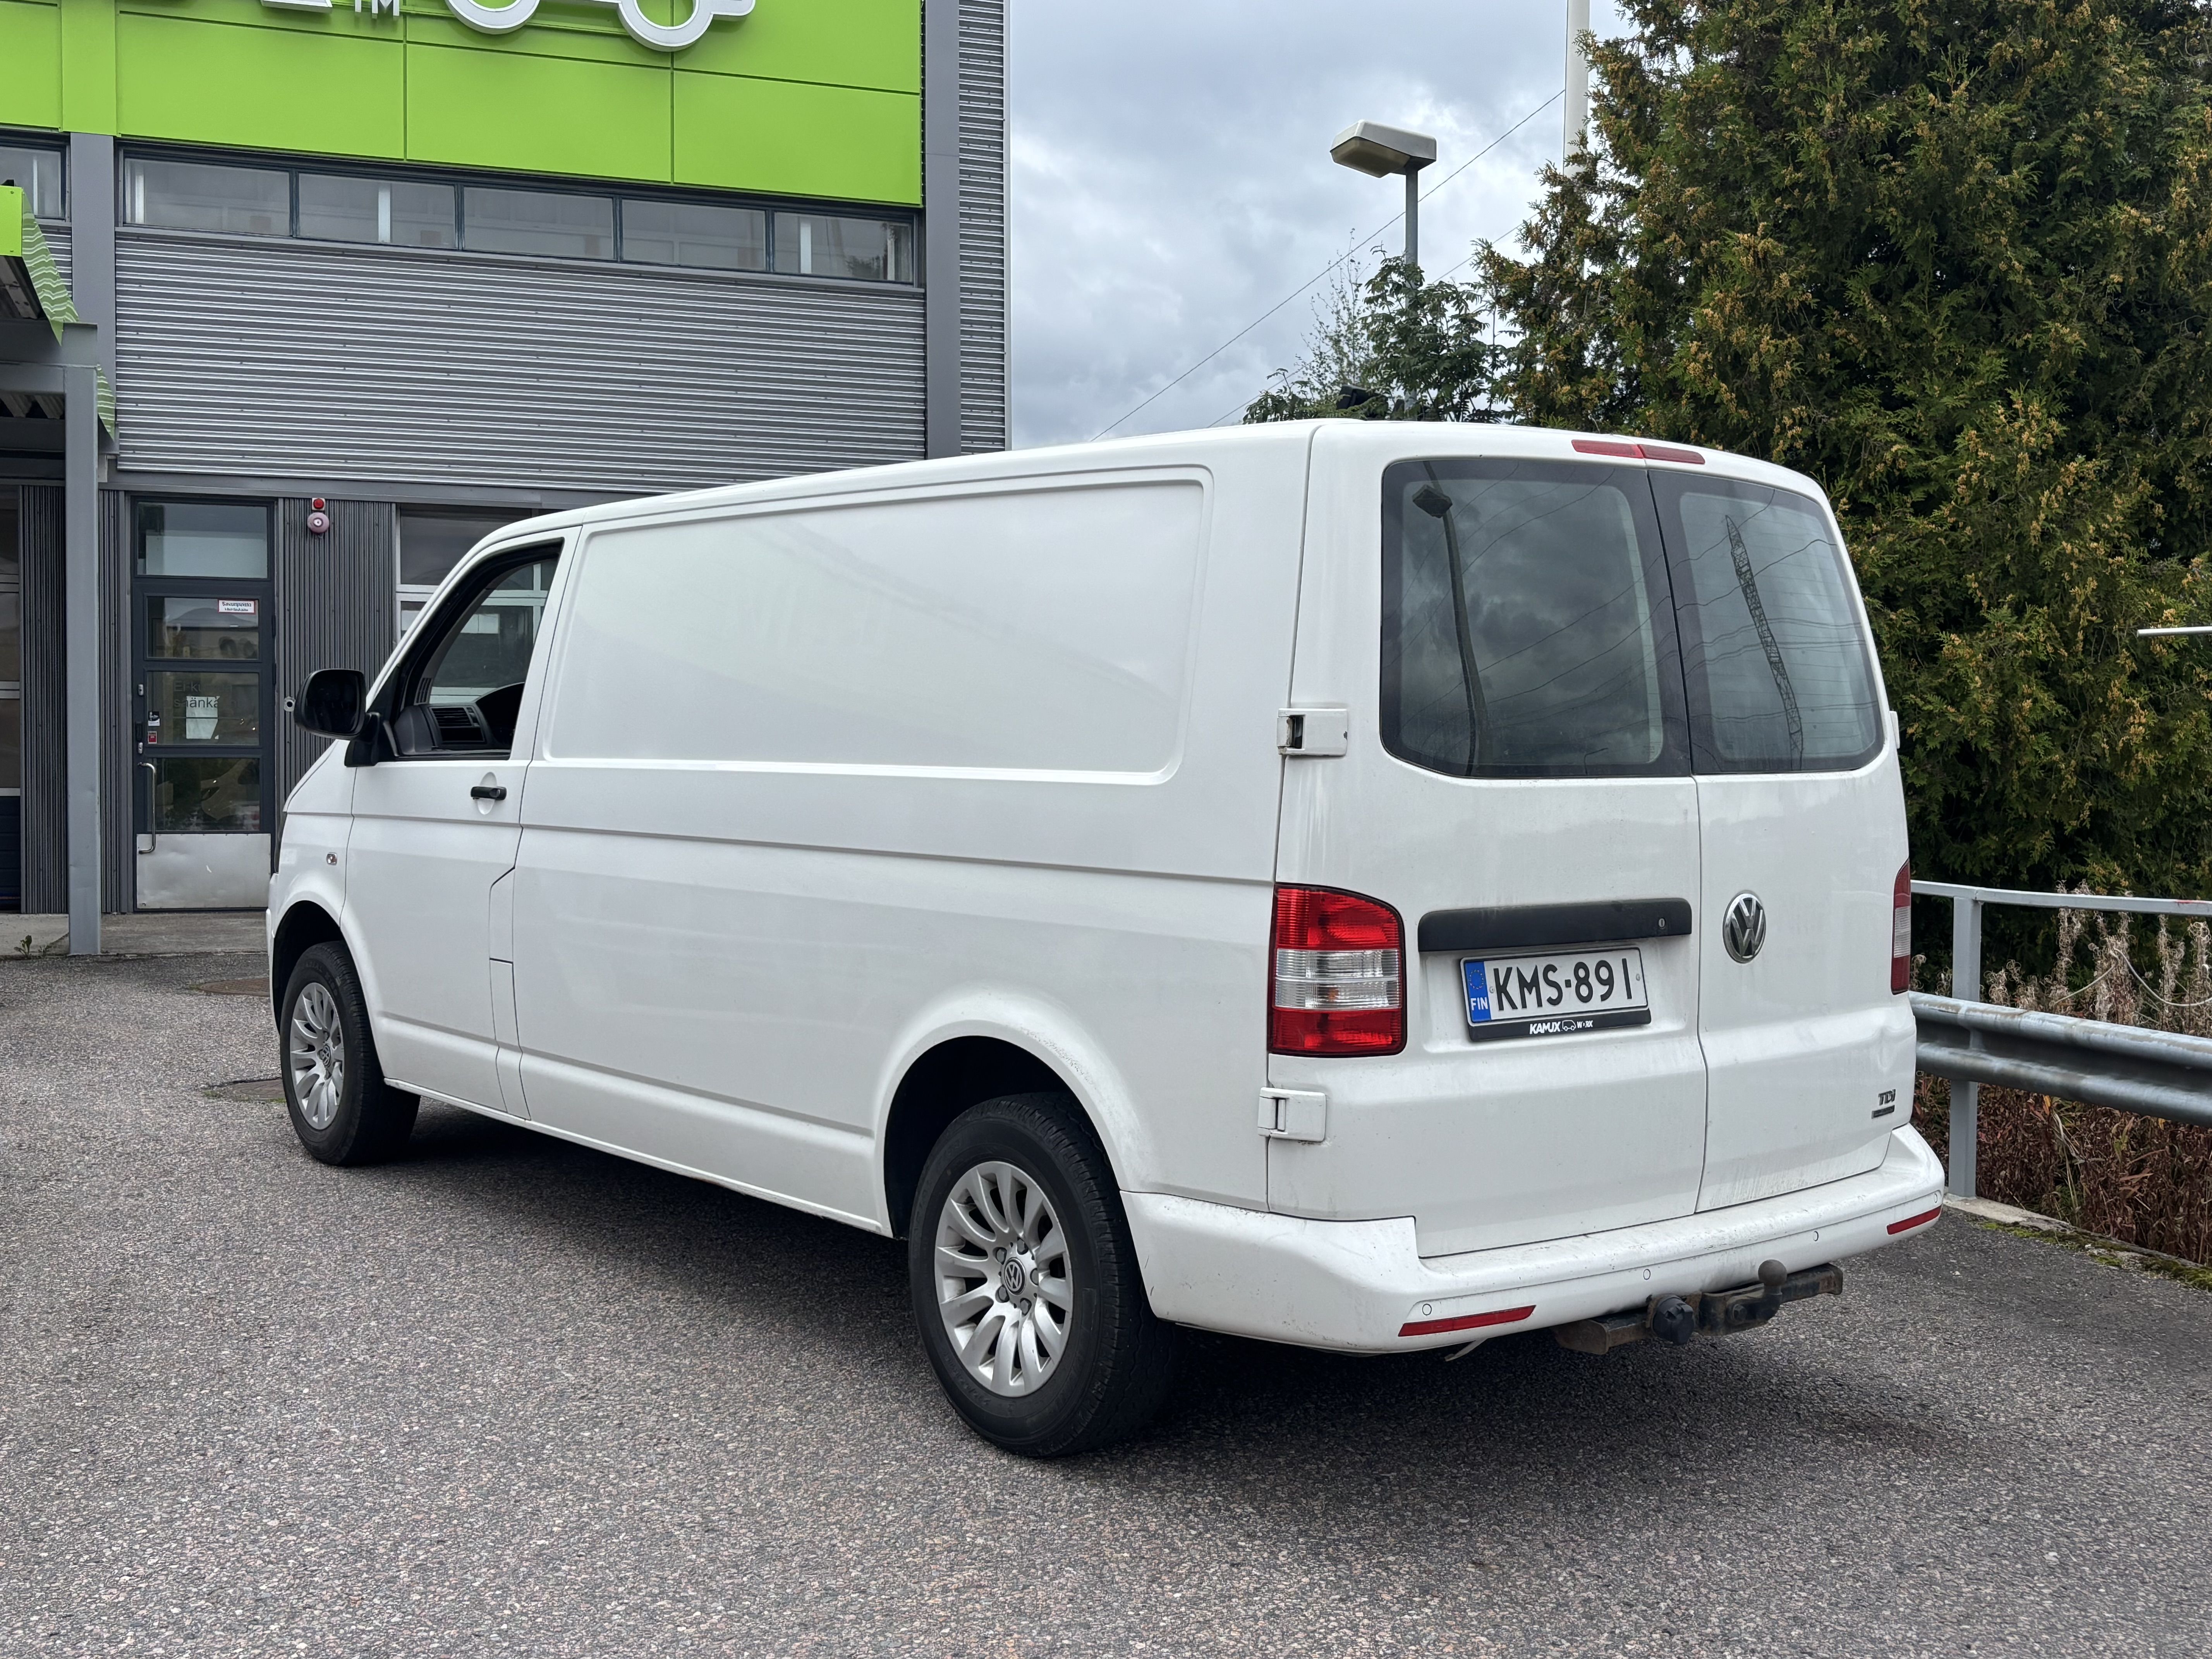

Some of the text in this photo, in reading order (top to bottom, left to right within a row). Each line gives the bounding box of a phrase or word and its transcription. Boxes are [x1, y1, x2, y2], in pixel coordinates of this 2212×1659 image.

[1470, 958, 1632, 1011] FIN KMS-891
[1529, 1021, 1561, 1034] KAMUX
